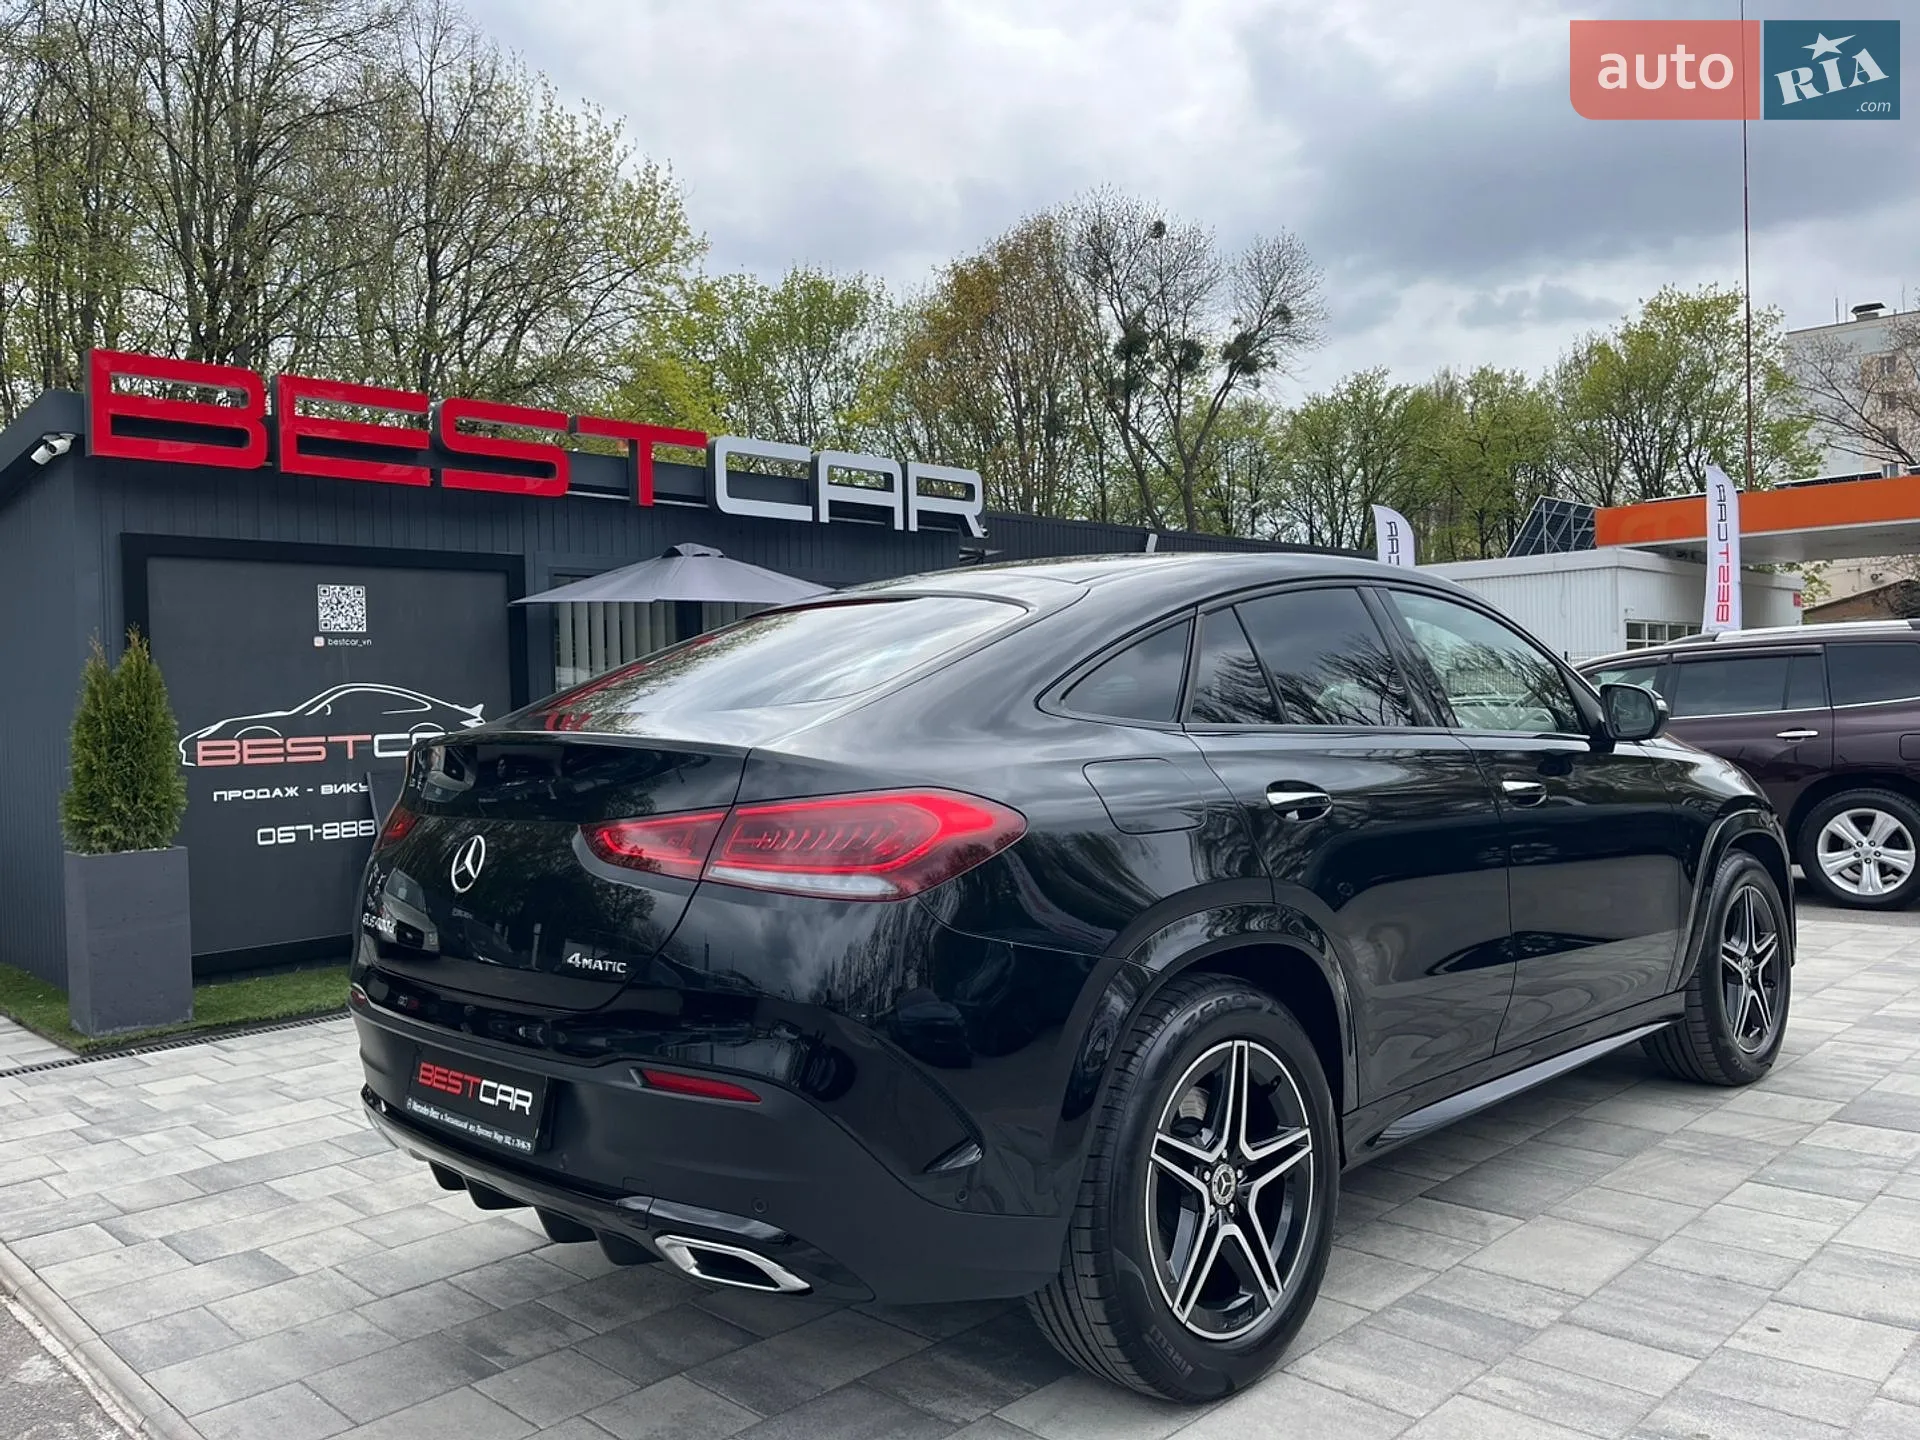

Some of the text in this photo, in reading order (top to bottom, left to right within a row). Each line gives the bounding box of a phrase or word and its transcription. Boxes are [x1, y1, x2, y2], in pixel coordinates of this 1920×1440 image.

[86, 348, 986, 538] BESTCAR
[213, 786, 299, 802] ПРОДАЖ
[257, 819, 375, 846] 067-888
[567, 952, 627, 973] 4MATIC
[418, 1062, 533, 1115] BESTCAR
